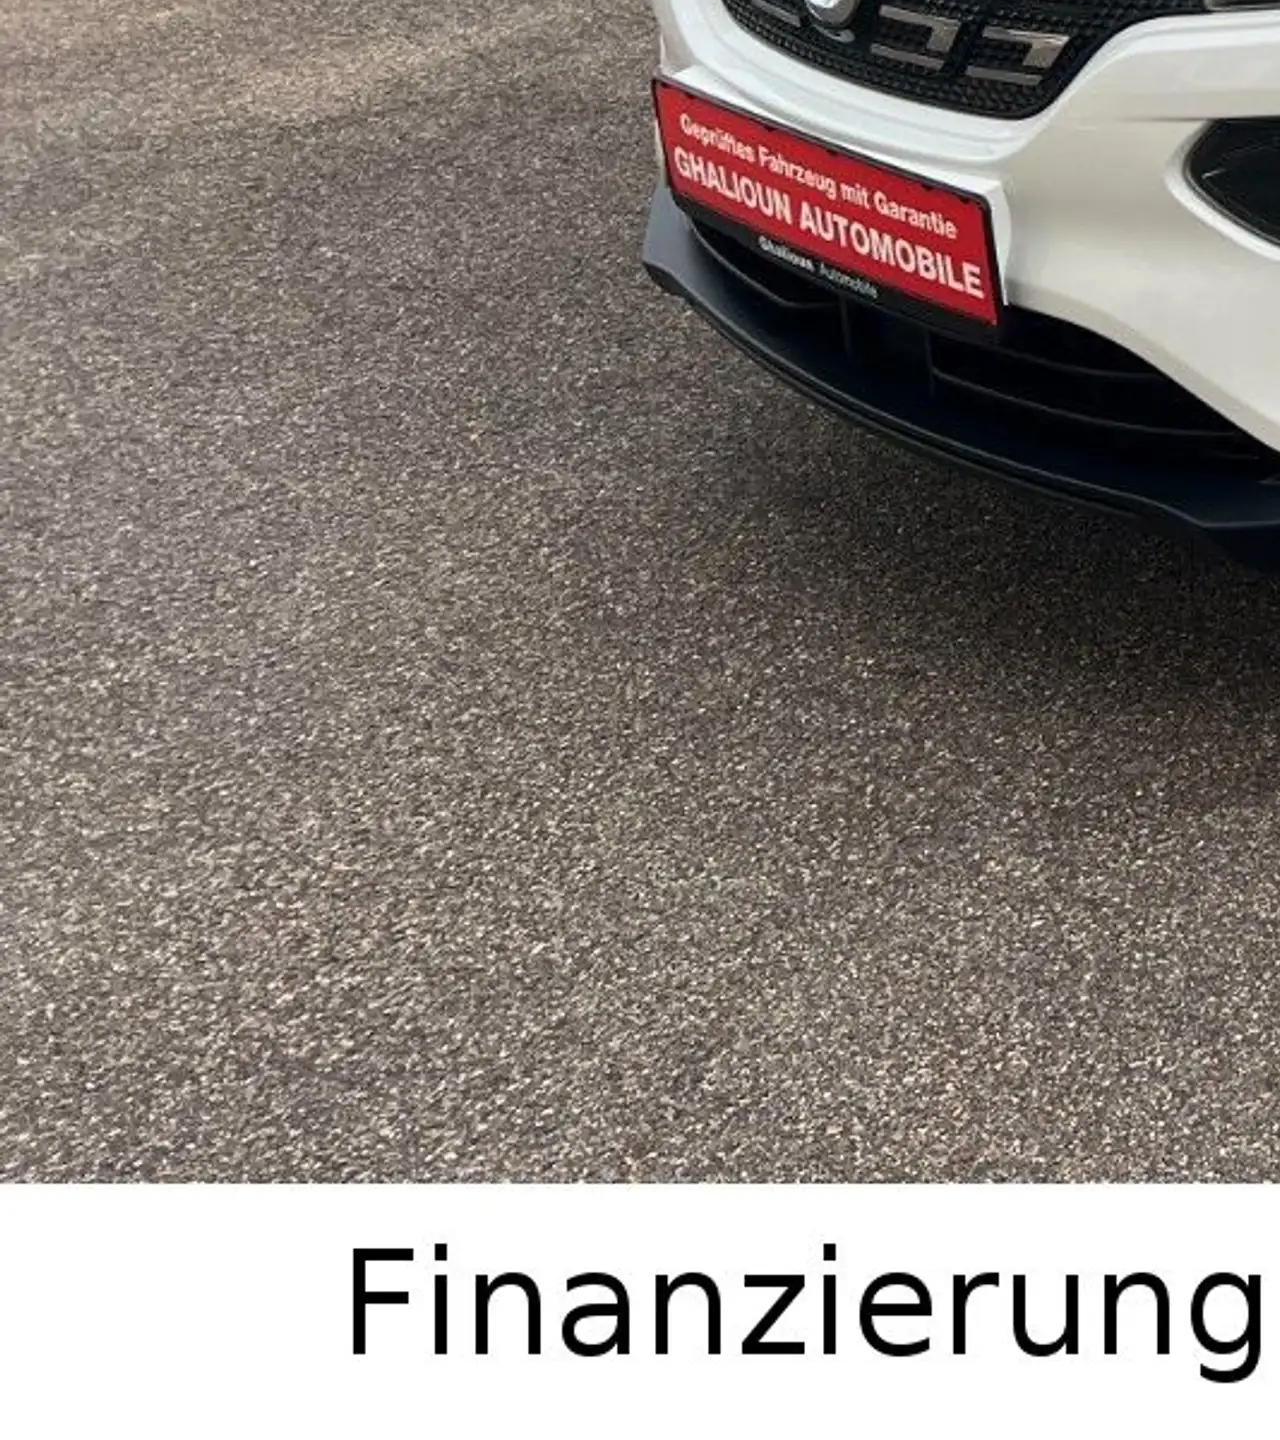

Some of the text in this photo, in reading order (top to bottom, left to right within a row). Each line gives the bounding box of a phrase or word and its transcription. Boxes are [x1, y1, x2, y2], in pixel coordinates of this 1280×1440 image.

[674, 146, 985, 300] GHALIOUN AUTOMOBILE
[679, 112, 958, 240] Geprüftes Fahrzeug mit Garantie
